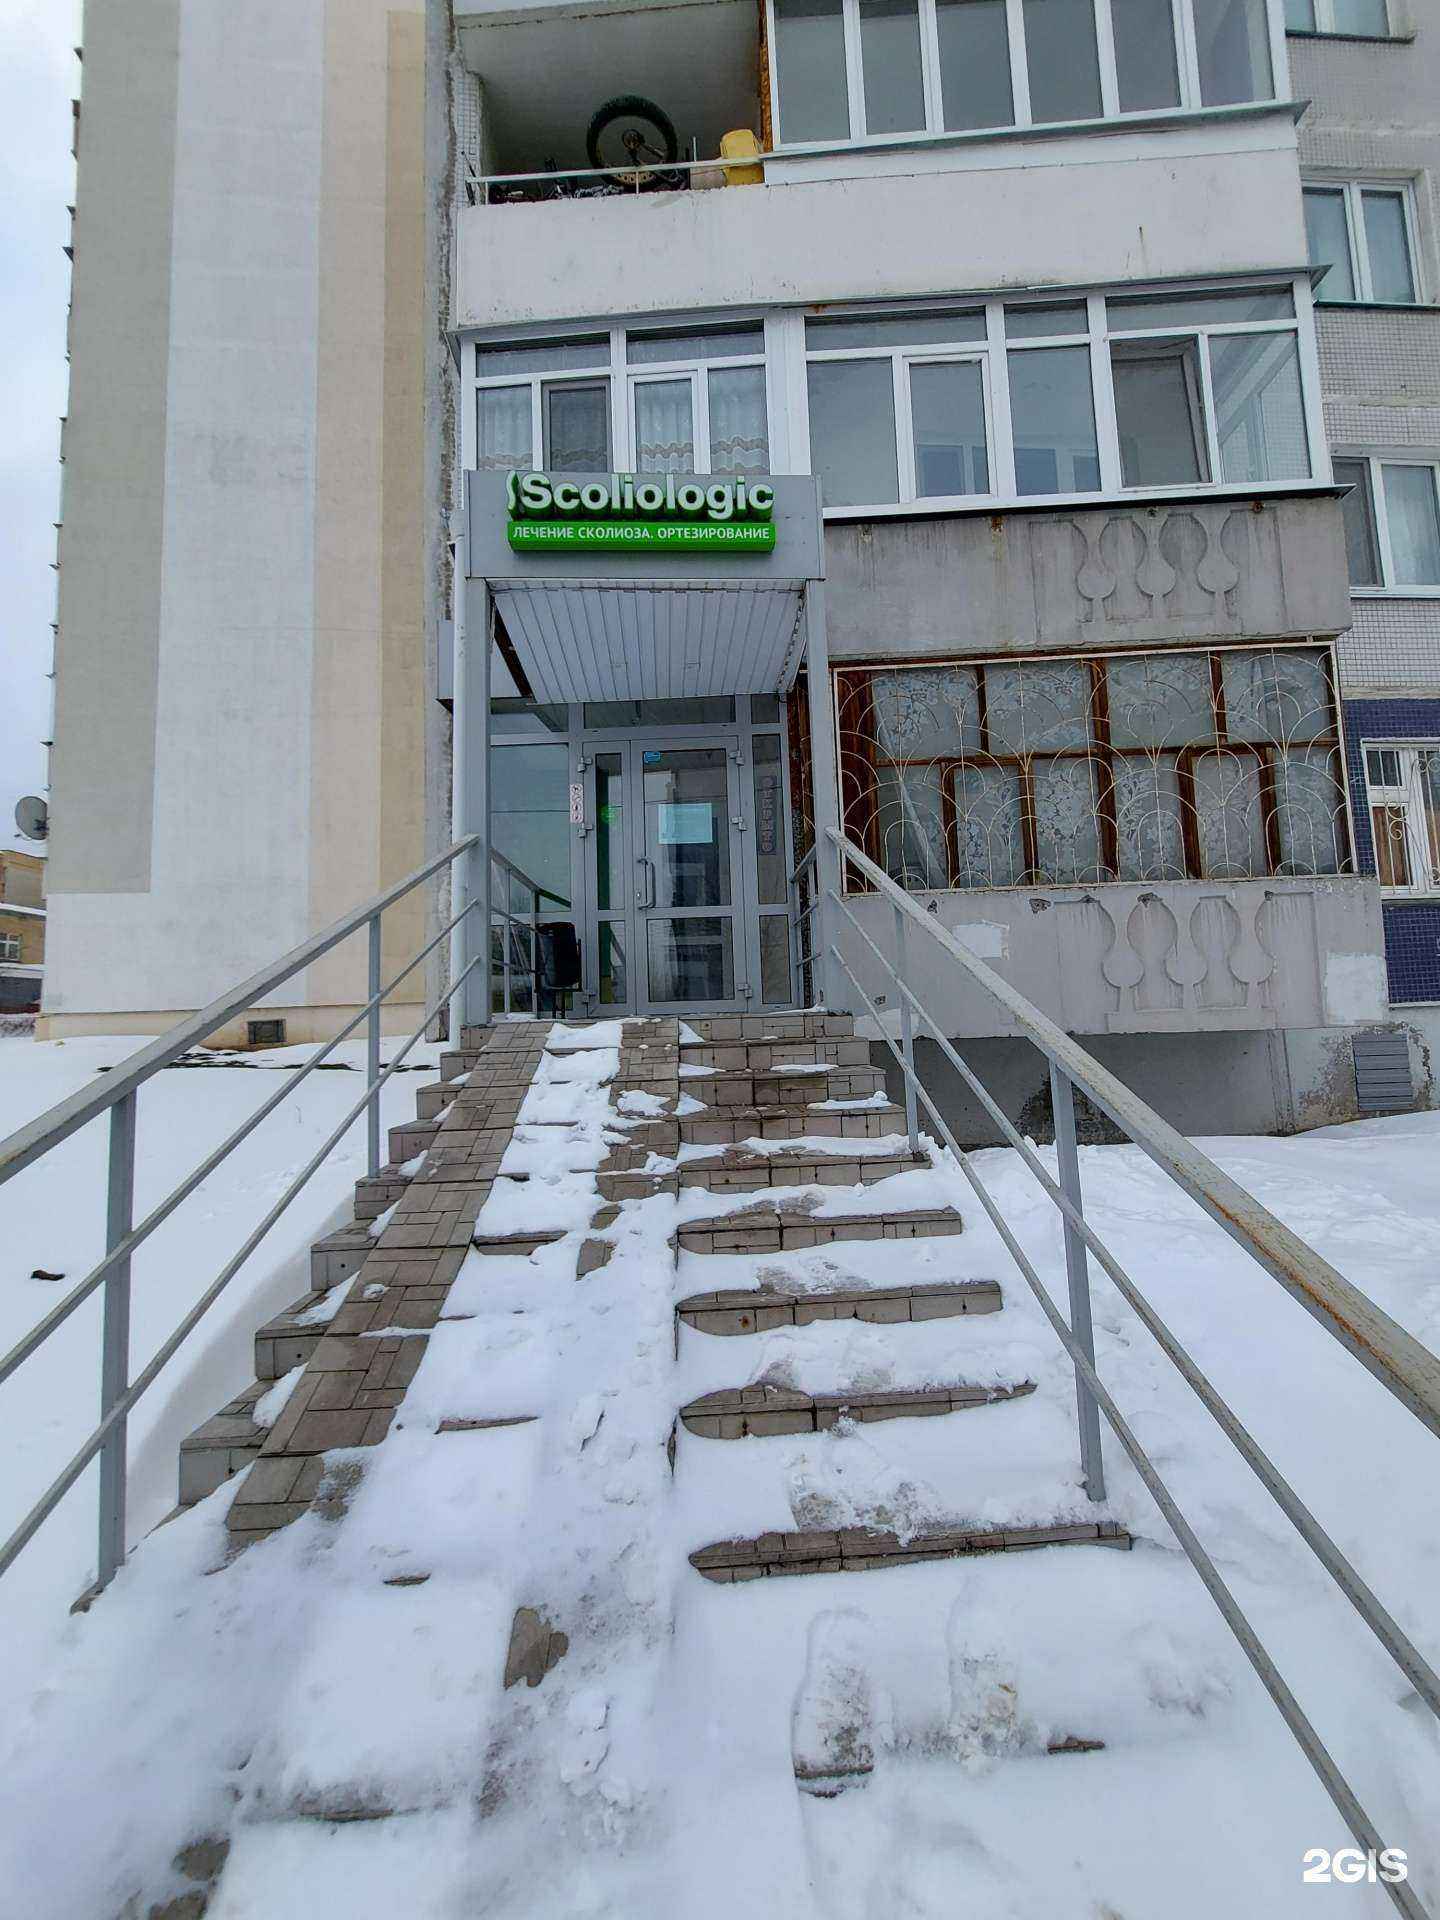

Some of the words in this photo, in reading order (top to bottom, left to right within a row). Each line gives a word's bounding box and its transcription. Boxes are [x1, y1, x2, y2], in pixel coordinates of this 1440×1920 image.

[521, 473, 775, 520] Scoliologic
[513, 526, 574, 539] ЛЕЧЕНИЕ
[577, 526, 654, 540] СКОЛИОЗА.
[657, 527, 770, 540] ОРТЕЗИРОВАНИЕ
